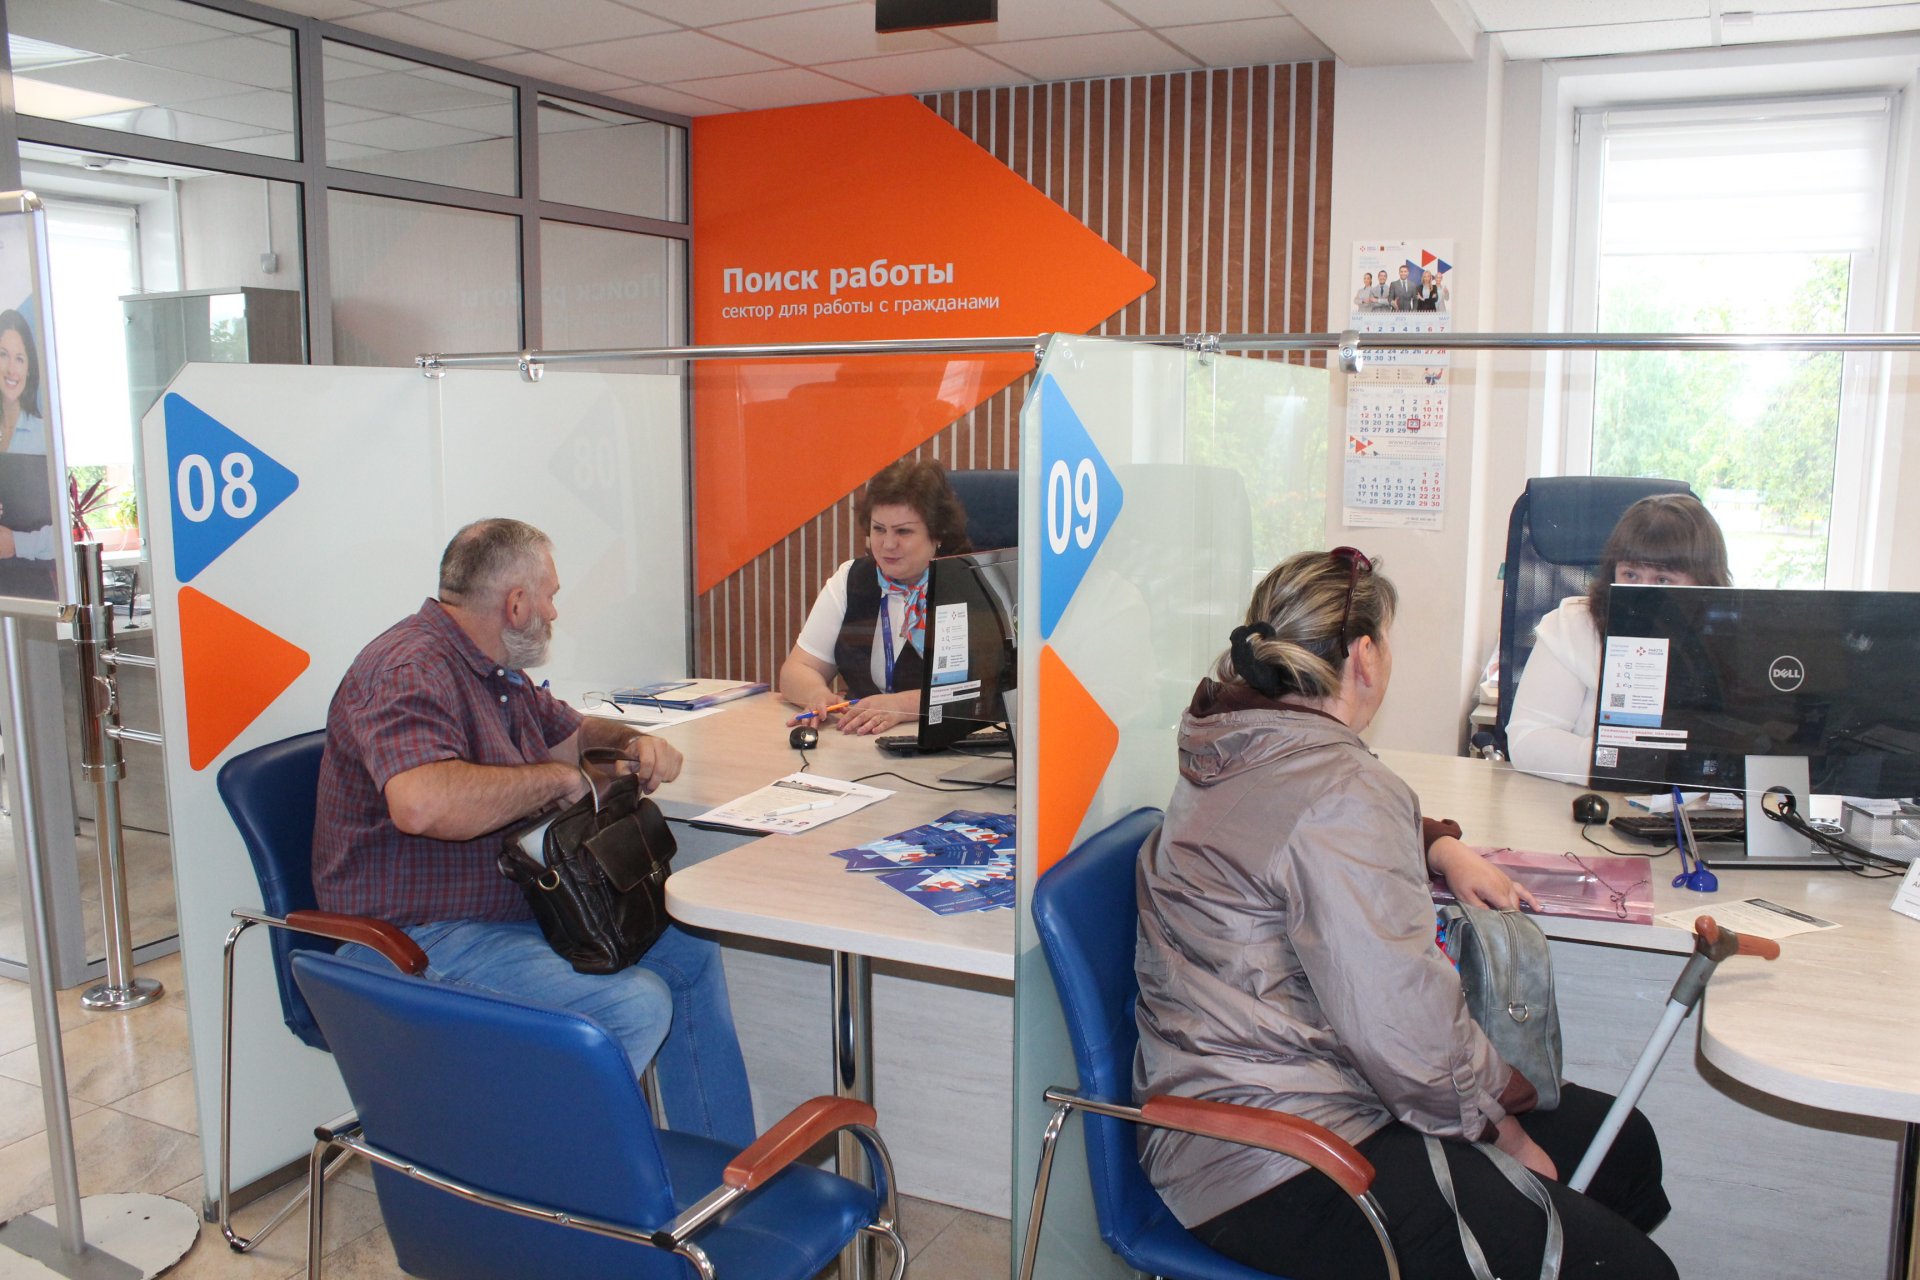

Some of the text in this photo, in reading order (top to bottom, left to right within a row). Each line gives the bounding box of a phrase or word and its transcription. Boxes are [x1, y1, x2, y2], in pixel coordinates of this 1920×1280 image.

[723, 259, 954, 295] Поиск работы
[722, 296, 1000, 320] сектор для работы с гражданами
[178, 452, 257, 523] 08
[1047, 458, 1098, 555] 09
[1773, 668, 1800, 678] DELL
